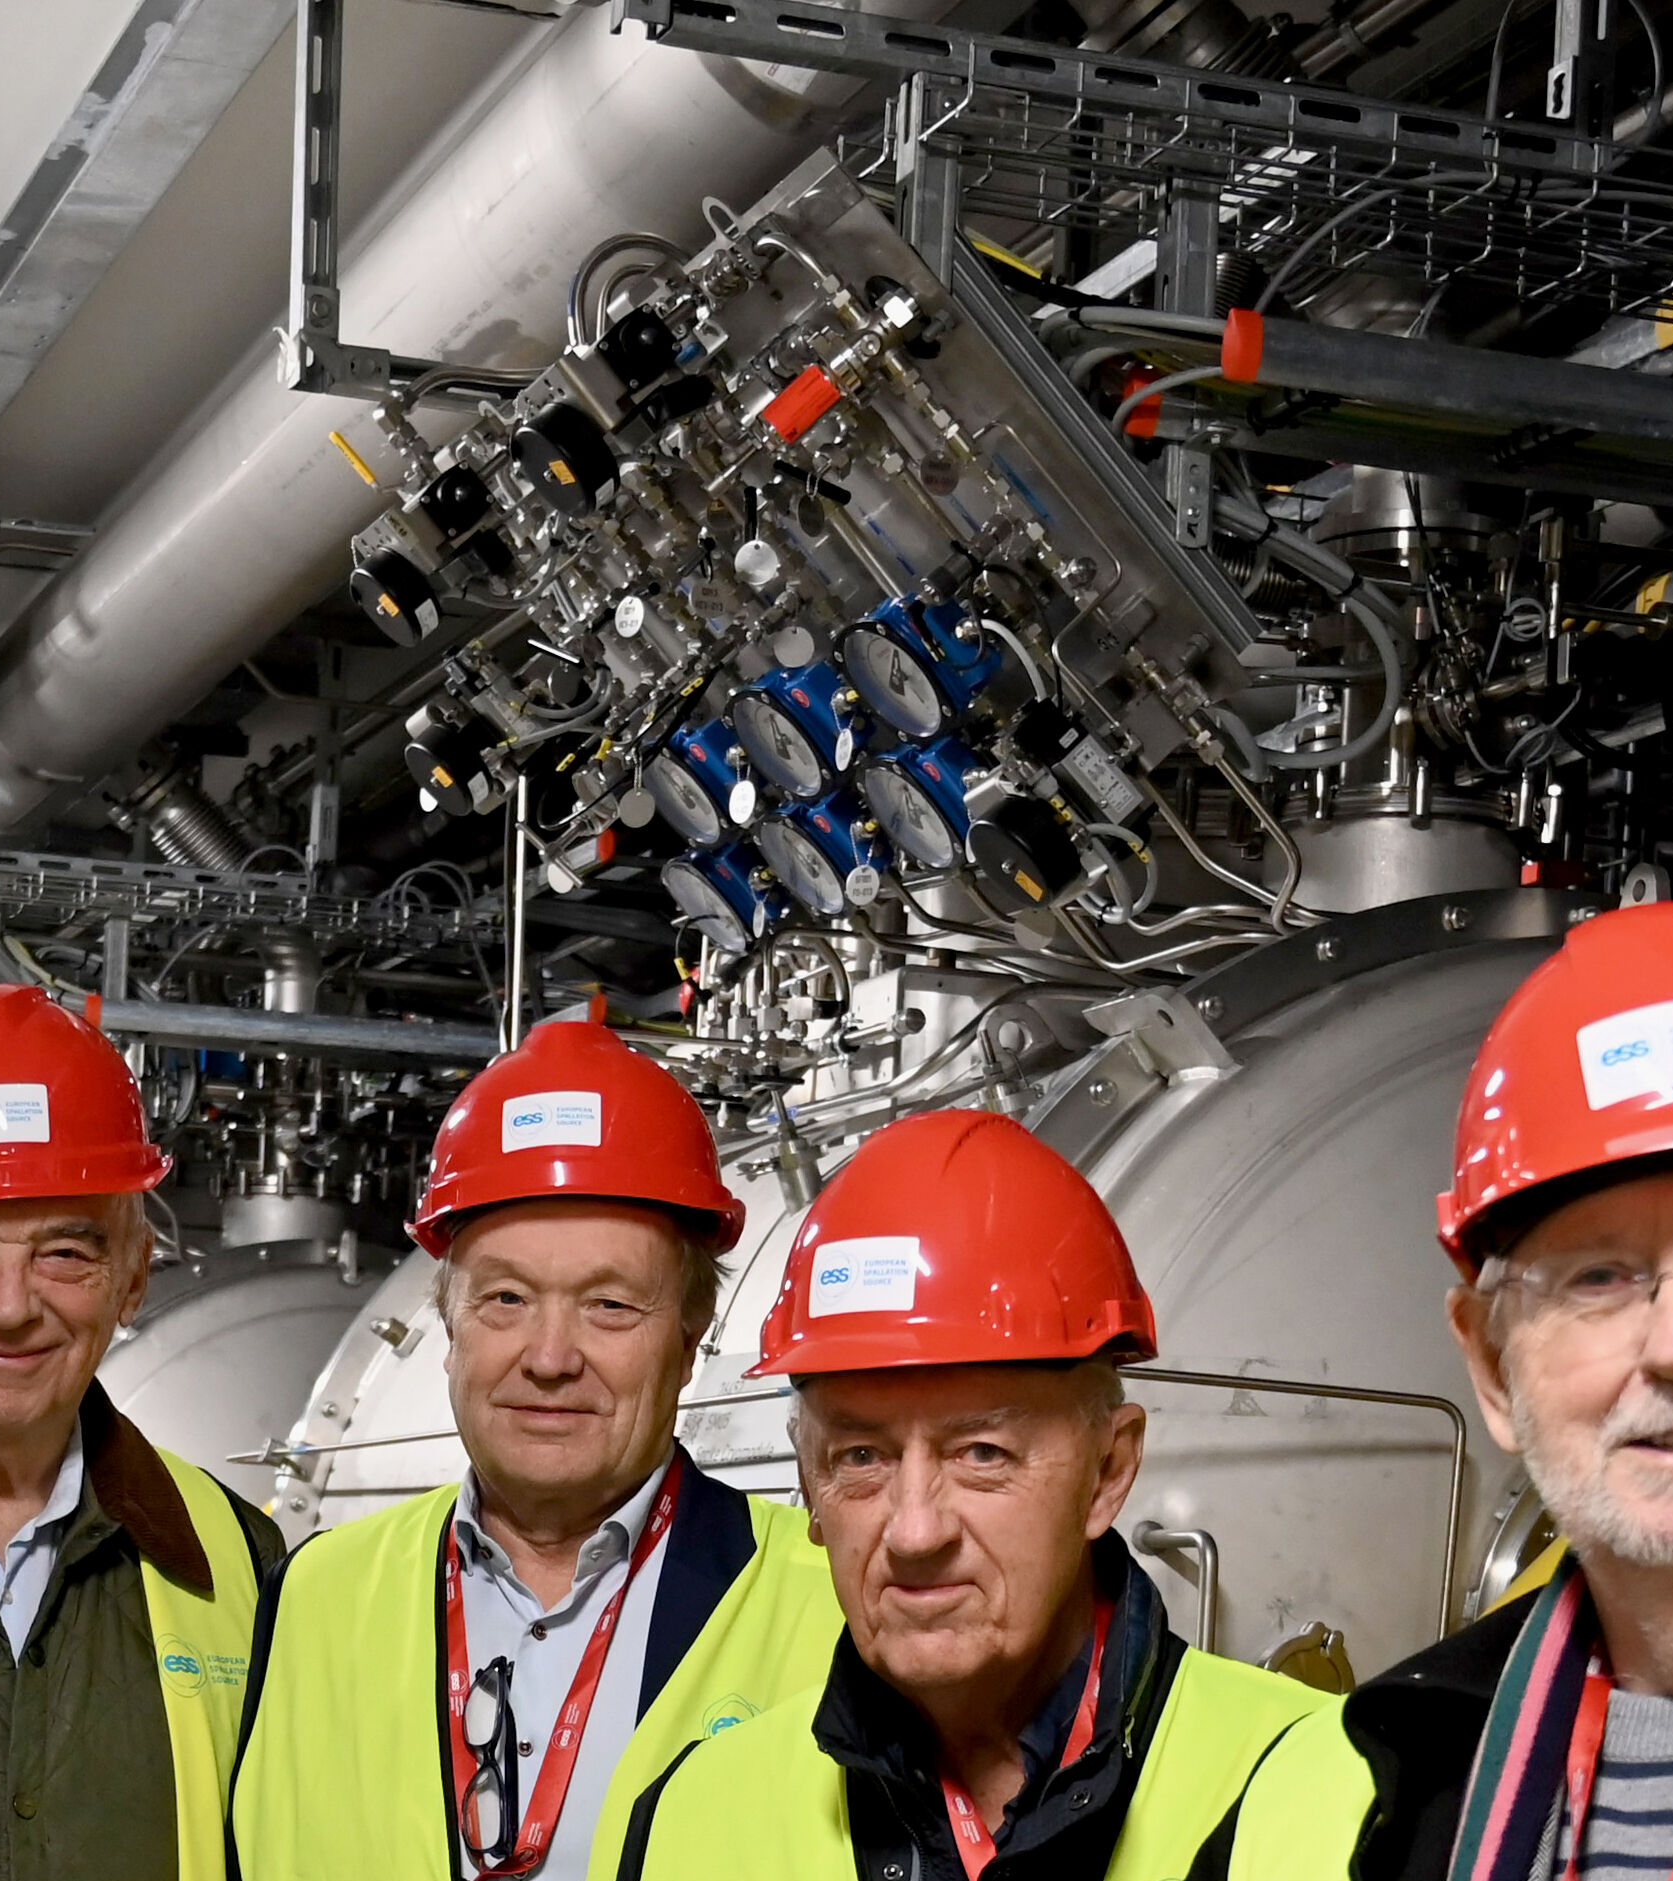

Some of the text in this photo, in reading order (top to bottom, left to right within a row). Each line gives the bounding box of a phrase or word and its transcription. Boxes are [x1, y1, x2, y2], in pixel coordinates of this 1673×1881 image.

[1601, 1039, 1649, 1067] ess
[513, 1113, 543, 1127] ess
[820, 1267, 849, 1286] ess
